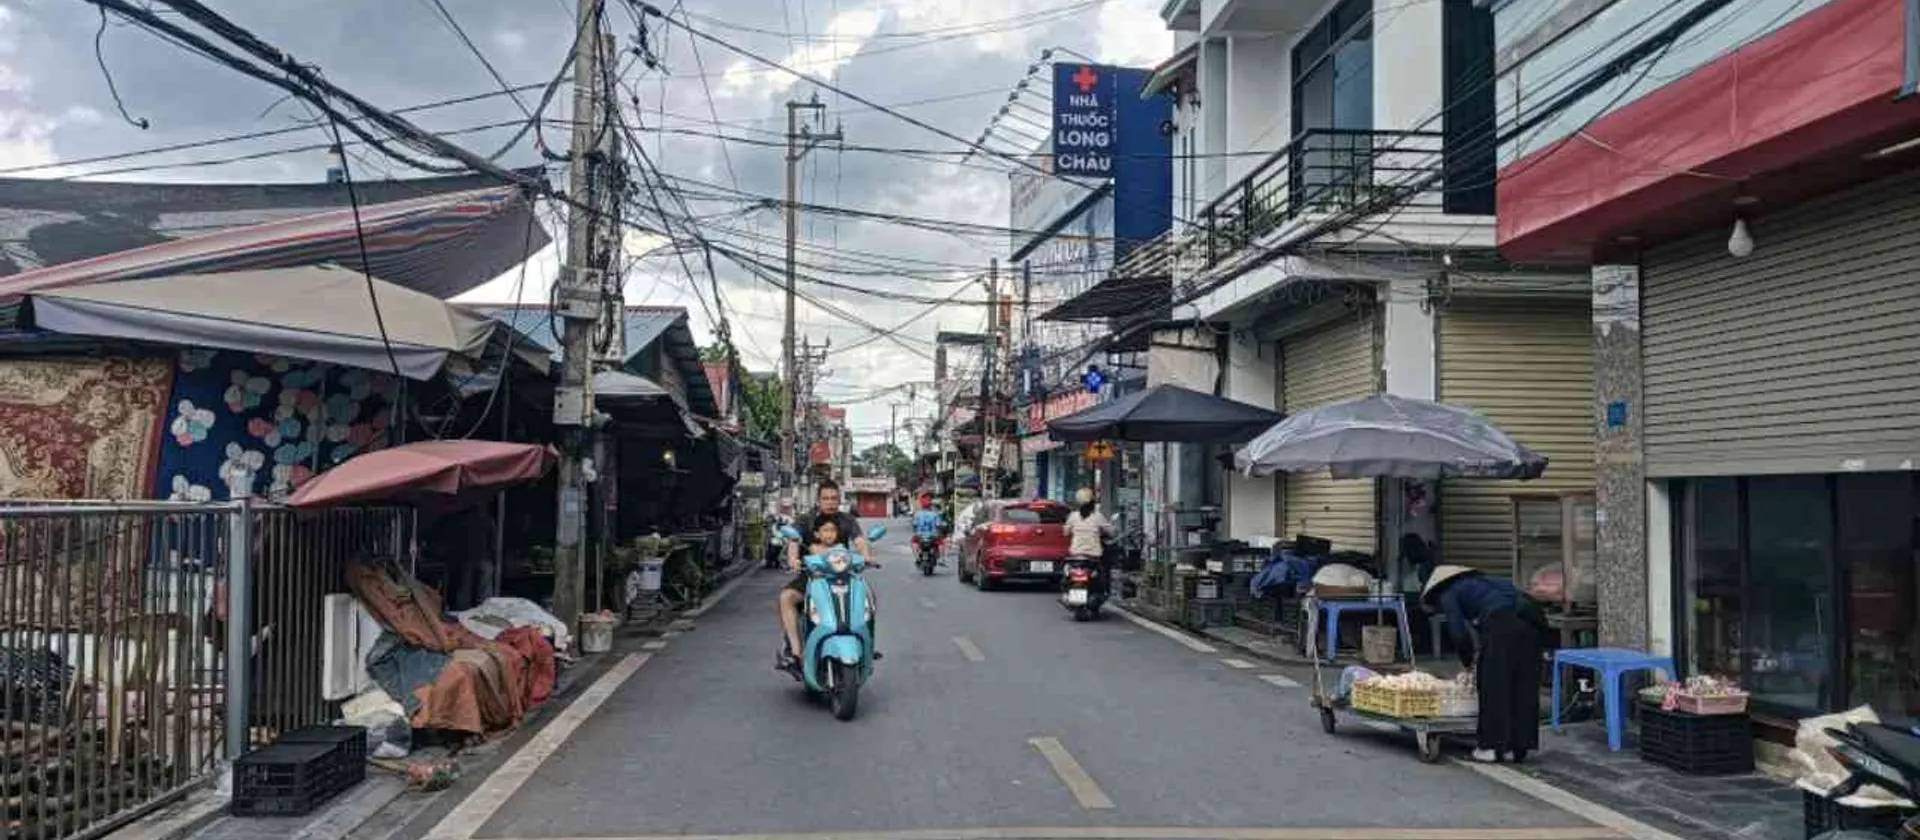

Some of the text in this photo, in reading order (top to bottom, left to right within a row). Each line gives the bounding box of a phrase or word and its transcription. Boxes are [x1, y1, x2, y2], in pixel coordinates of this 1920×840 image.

[1061, 111, 1108, 127] THUỐC
[1058, 130, 1109, 147] LONG
[1058, 151, 1111, 171] CHÂU
